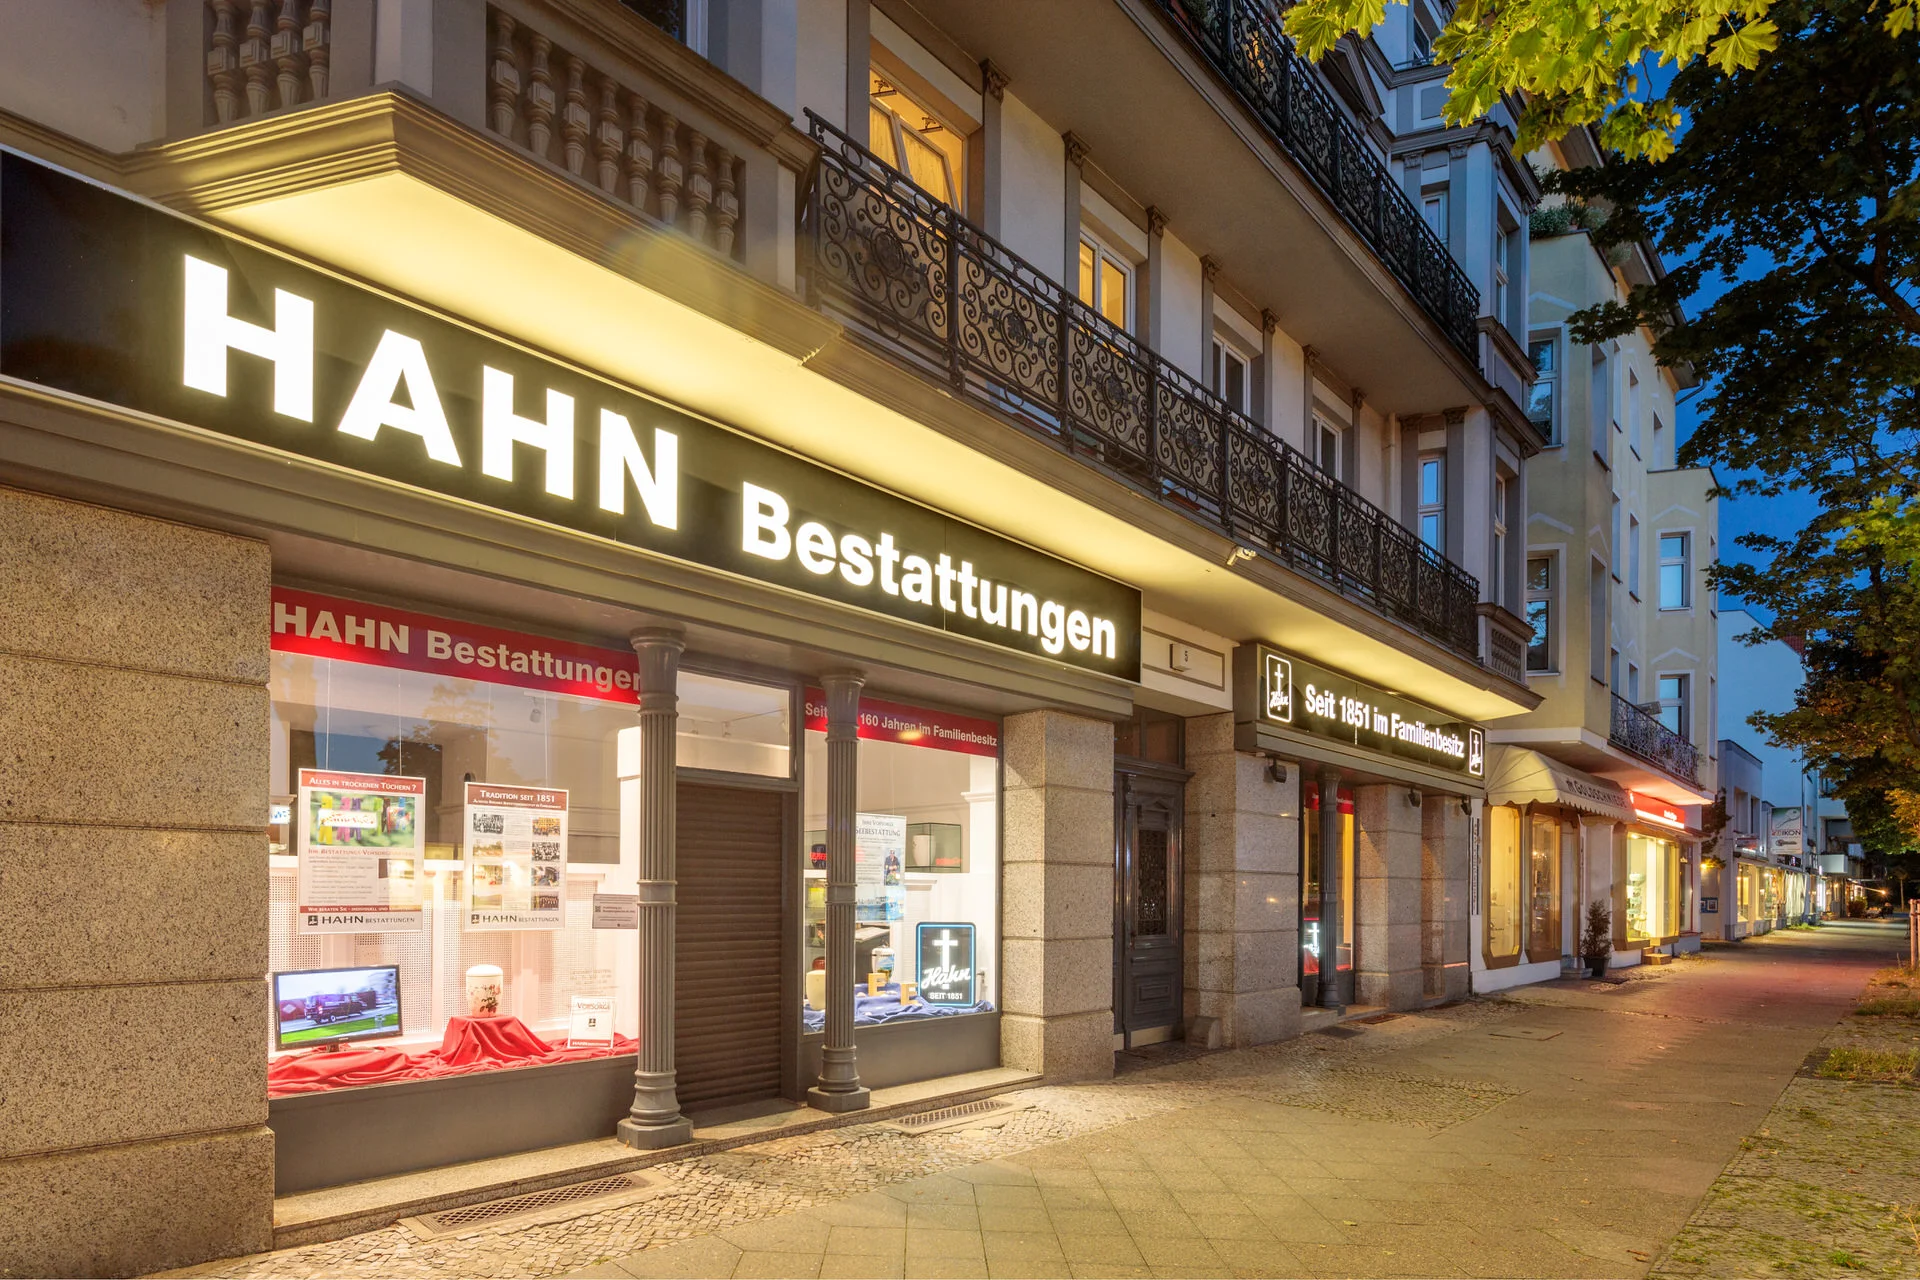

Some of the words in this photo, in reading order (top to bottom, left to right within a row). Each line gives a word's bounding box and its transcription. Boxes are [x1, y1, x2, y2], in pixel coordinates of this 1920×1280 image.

[181, 252, 680, 532] HAHN
[741, 480, 1119, 657] Bestattungen
[273, 601, 410, 654] HAHN
[804, 702, 828, 717] Seit
[860, 712, 879, 727] 160
[881, 716, 918, 734] Jahren
[919, 721, 931, 736] im
[933, 725, 998, 747] Familienbesitz
[1305, 683, 1336, 719] Seit
[1339, 695, 1371, 730] 1851
[1373, 706, 1389, 736] im
[1391, 712, 1465, 759] Familienbesitz
[308, 777, 331, 786] ALLES
[479, 789, 518, 800] TRADITION
[519, 793, 534, 802] SEIT
[536, 794, 555, 803] 1851
[322, 915, 364, 925] HAHN
[365, 916, 416, 924] BESTATTUNGEN
[482, 915, 518, 923] HAHN
[921, 964, 971, 989] Hahn
[928, 991, 947, 1000] SEIT
[947, 992, 963, 1000] 1851
